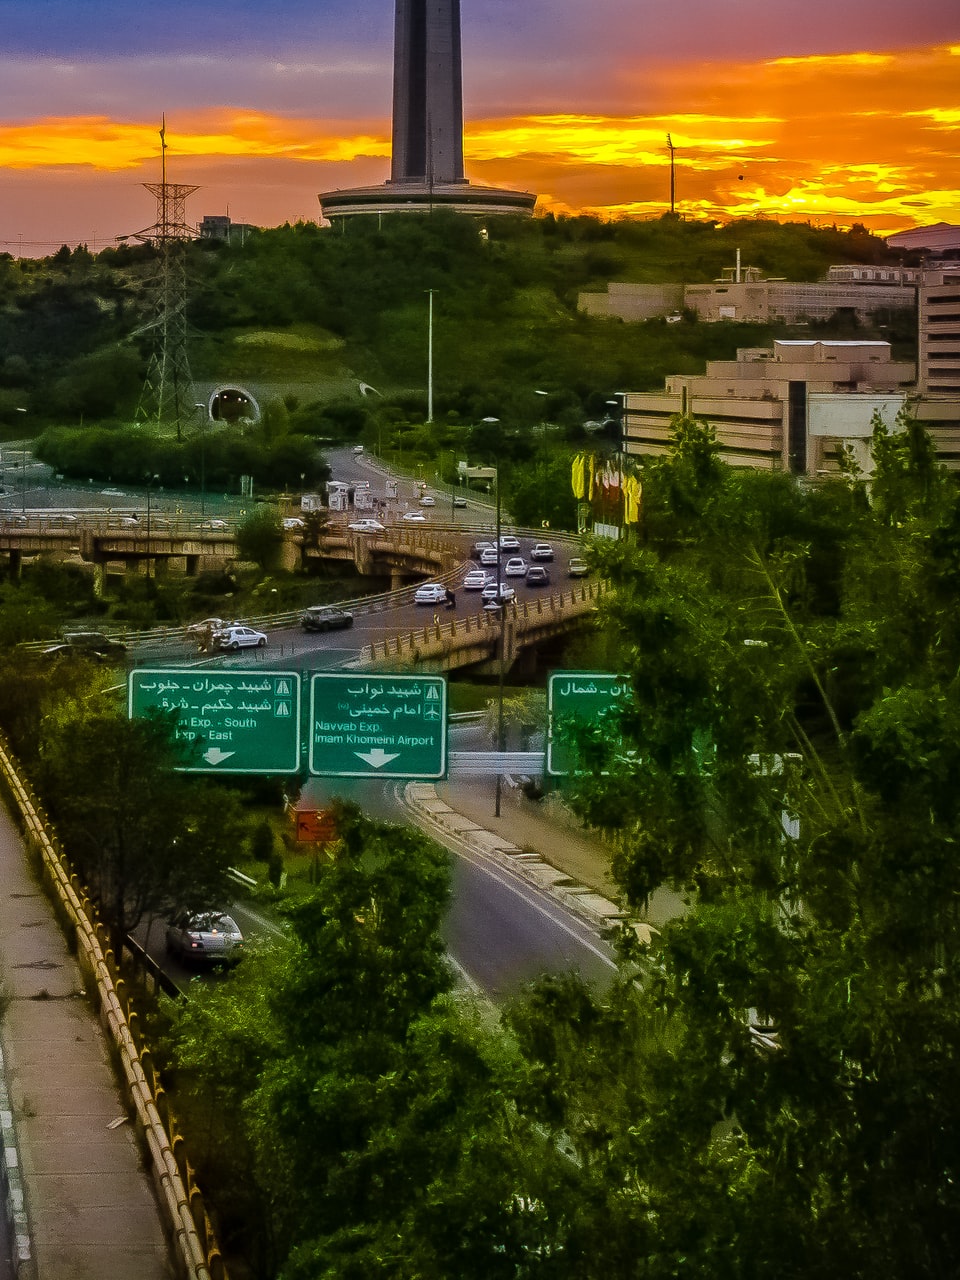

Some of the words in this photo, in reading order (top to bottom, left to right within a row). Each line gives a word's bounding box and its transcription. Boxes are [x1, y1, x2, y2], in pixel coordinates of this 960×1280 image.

[139, 679, 180, 695] جنوب
[192, 678, 234, 696] چمران
[237, 679, 272, 693] شهید
[347, 683, 384, 700] نواب
[387, 683, 422, 698] شهید
[560, 682, 598, 696] شمال
[201, 699, 234, 715] حکیم
[237, 698, 272, 713] شهید
[349, 703, 391, 718] خمینی
[393, 704, 421, 719] امام
[190, 717, 214, 728] Exp.
[224, 717, 257, 728] South
[315, 721, 357, 731] Navvab
[360, 722, 383, 733] Exp.
[208, 730, 233, 740] East
[315, 733, 344, 744] Imam
[346, 734, 395, 745] Khomeini
[398, 735, 434, 747] Airport
